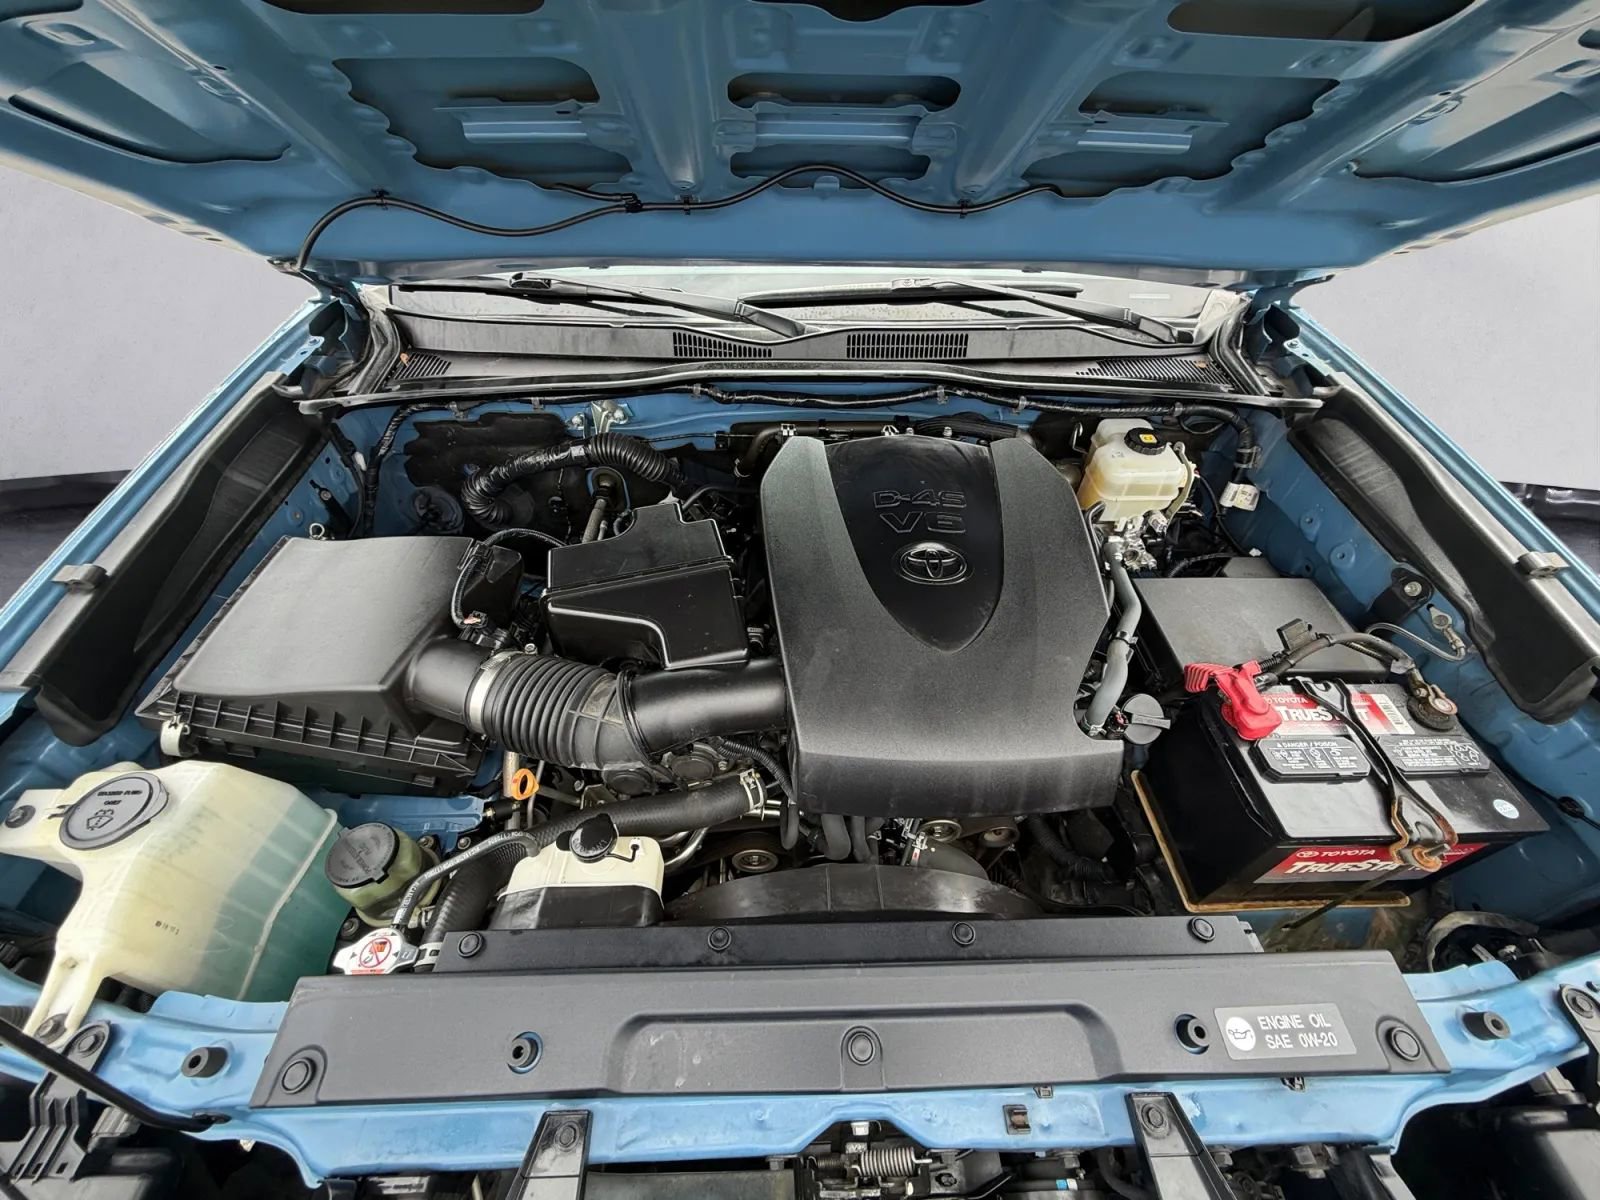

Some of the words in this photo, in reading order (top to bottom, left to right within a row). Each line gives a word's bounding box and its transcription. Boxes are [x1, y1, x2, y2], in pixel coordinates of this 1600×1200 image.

[880, 511, 966, 533] V6
[1274, 696, 1309, 704] TOYOTA
[1321, 849, 1376, 857] TOYOTA
[1257, 1014, 1305, 1030] ENGINE
[1308, 1013, 1332, 1028] OIL
[1265, 1034, 1294, 1049] SAE
[1299, 1032, 1338, 1048] 0W-20
